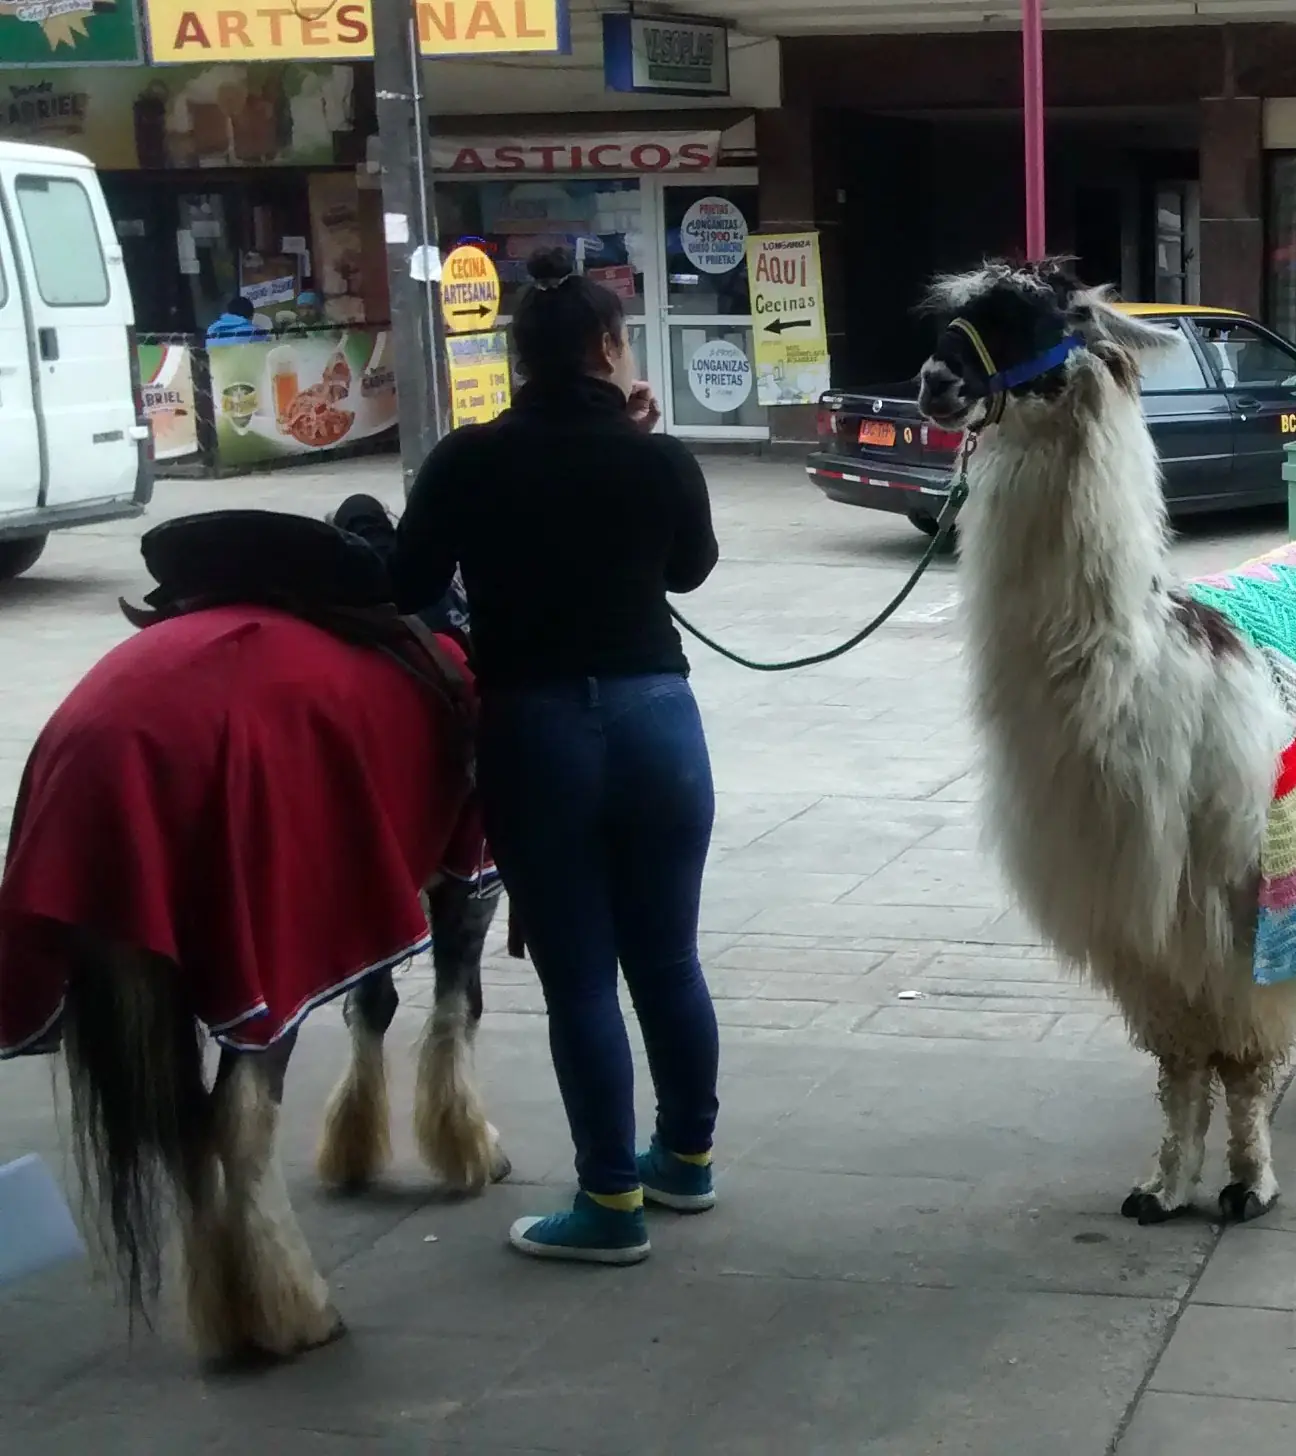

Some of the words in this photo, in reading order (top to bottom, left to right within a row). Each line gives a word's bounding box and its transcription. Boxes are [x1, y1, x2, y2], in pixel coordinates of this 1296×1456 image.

[173, 0, 547, 49] ARTESNAL
[450, 256, 487, 279] CECINA
[443, 281, 497, 305] ARTESANAL
[755, 293, 816, 315] Cecinas
[692, 359, 749, 373] LONGANIZAS
[696, 372, 704, 385] Y
[705, 373, 743, 386] PRIETAS
